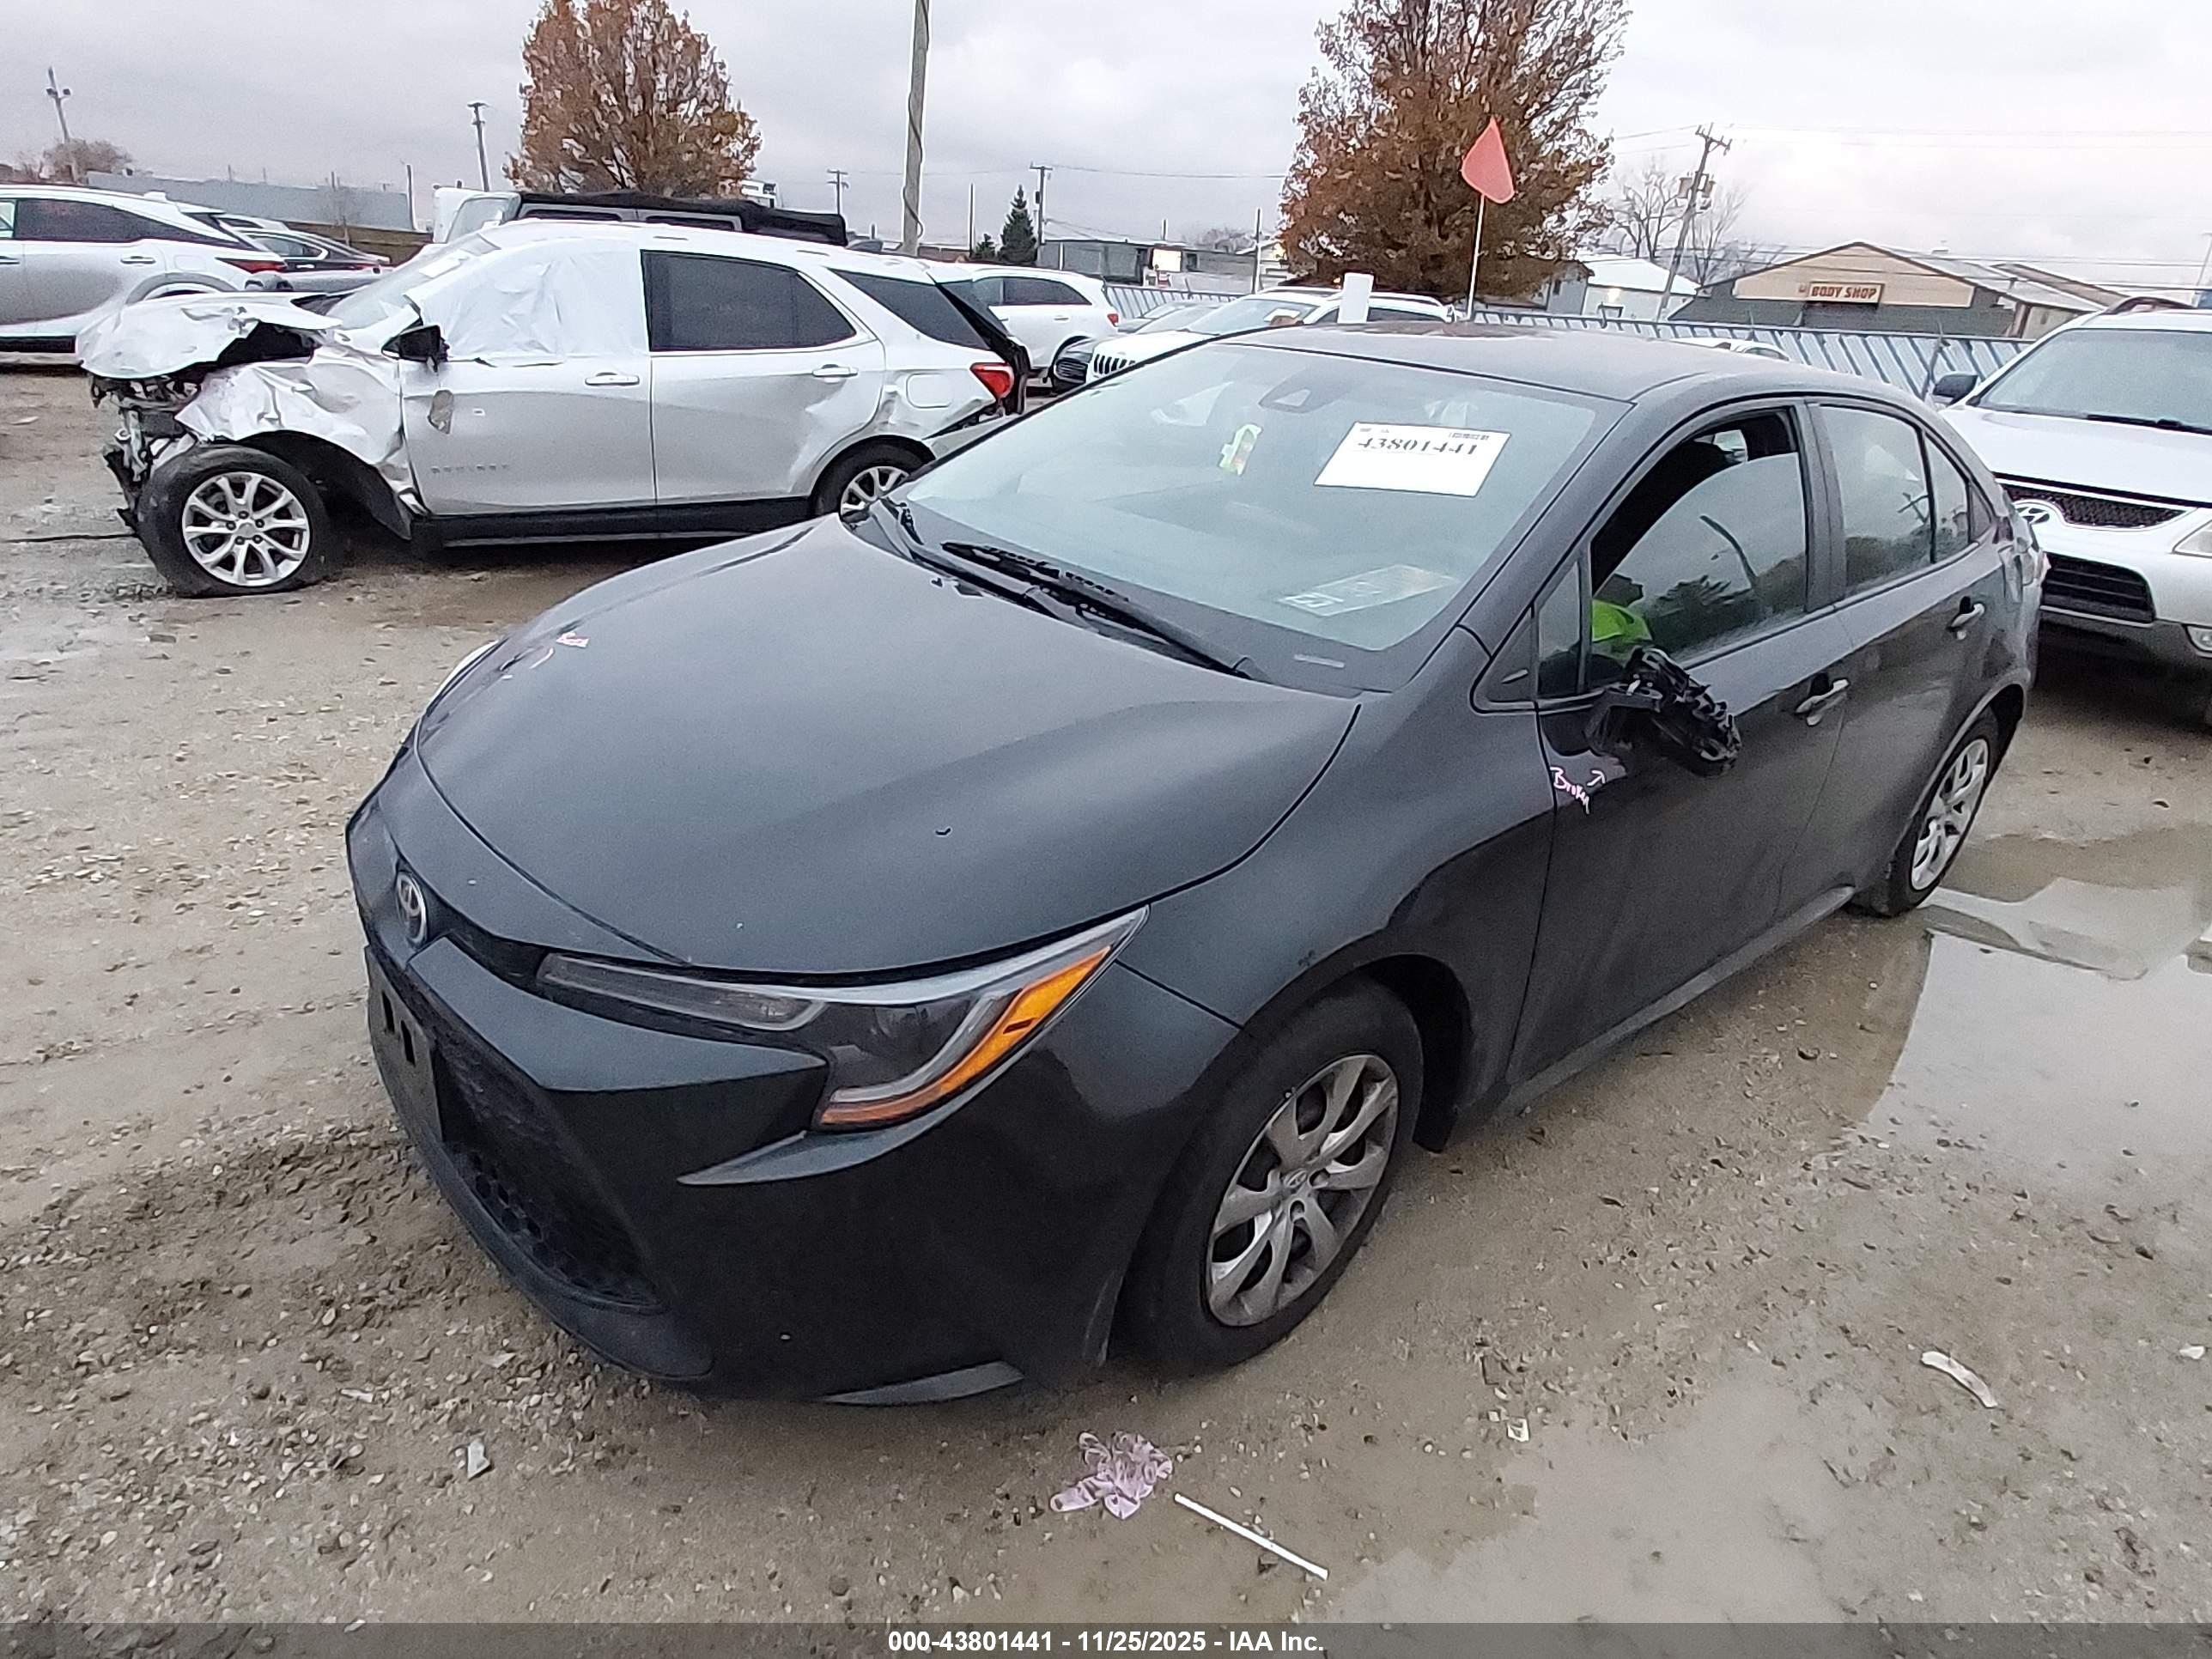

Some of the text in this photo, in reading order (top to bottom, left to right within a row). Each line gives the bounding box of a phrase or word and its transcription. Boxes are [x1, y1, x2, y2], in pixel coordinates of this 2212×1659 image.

[1811, 286, 1877, 299] BODY SHOP
[1358, 437, 1478, 455] 43801441
